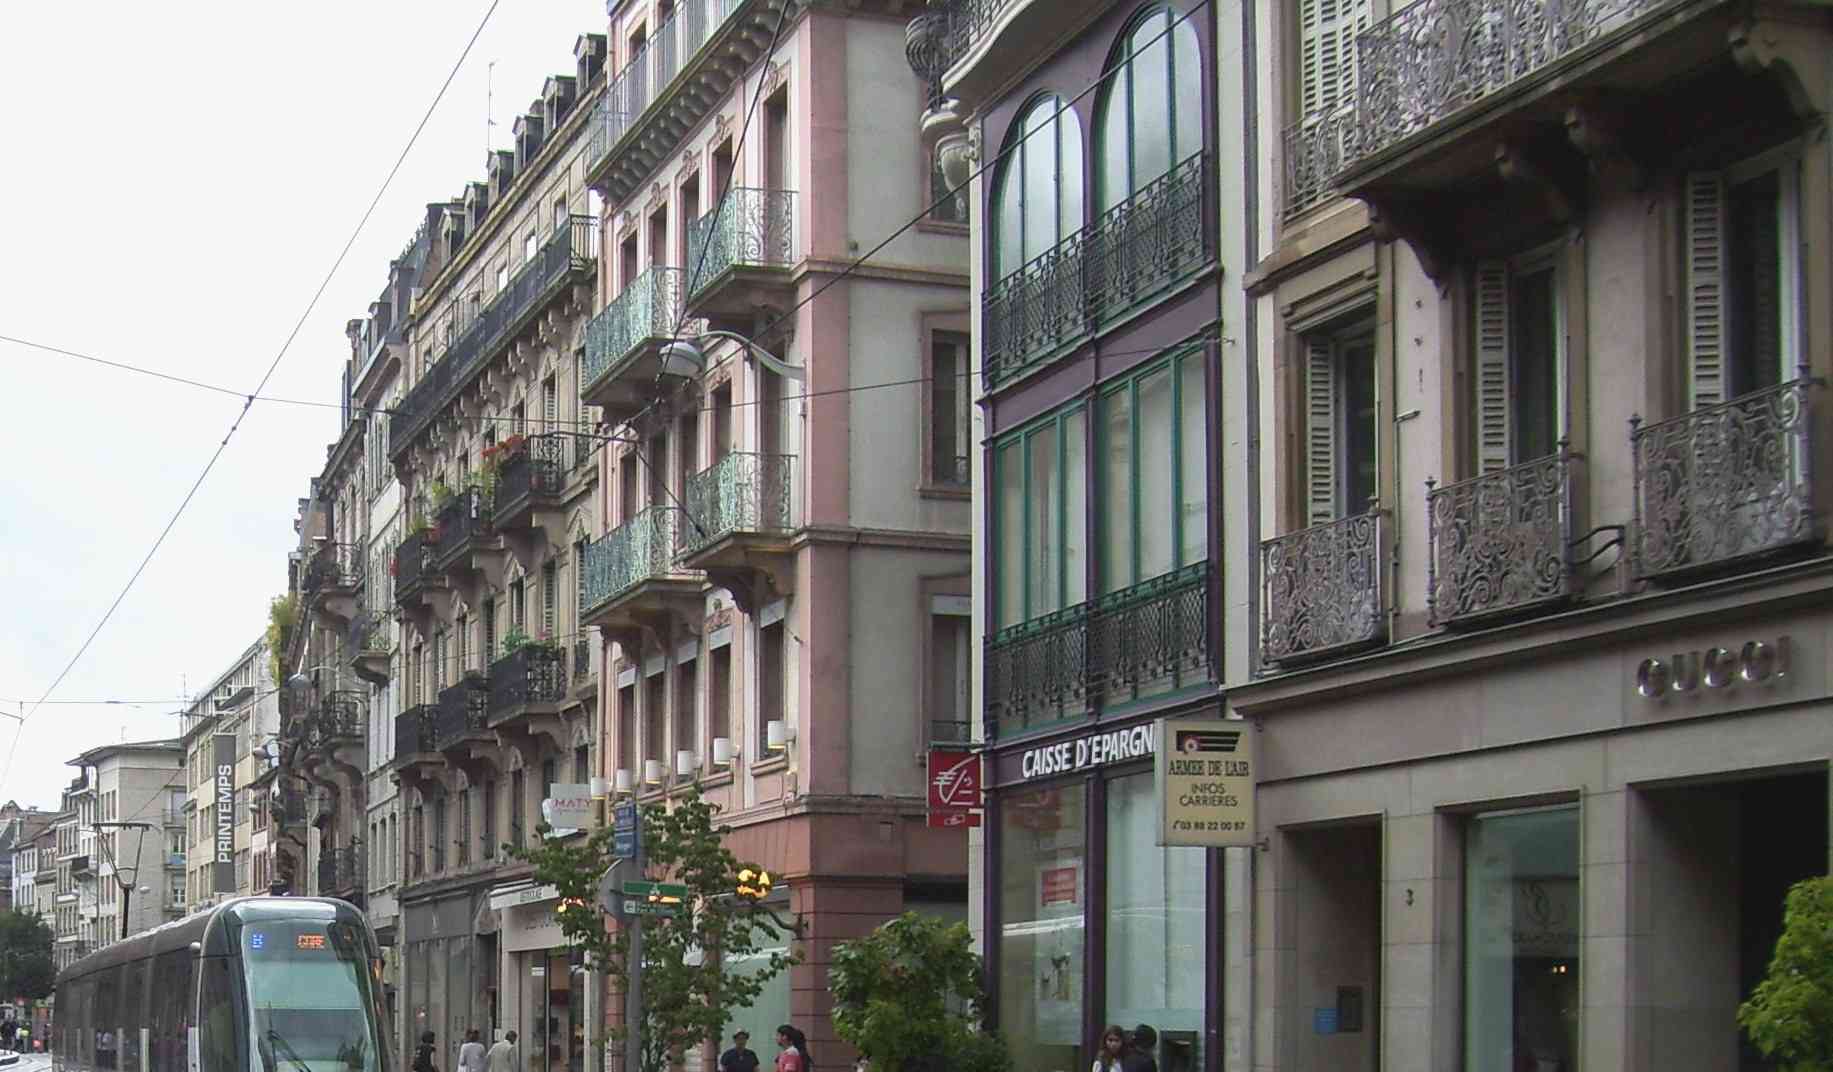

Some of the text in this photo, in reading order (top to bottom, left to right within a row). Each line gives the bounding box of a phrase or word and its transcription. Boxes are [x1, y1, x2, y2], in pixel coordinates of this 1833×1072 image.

[1637, 636, 1791, 698] GUCCI
[1022, 724, 1155, 778] CAISSE D'EPARGN
[1168, 760, 1249, 777] ARMEE DE L'AIR
[1179, 795, 1239, 807] CARRIERES
[1192, 783, 1225, 795] INFOS
[218, 764, 233, 863] PRINTEMPS
